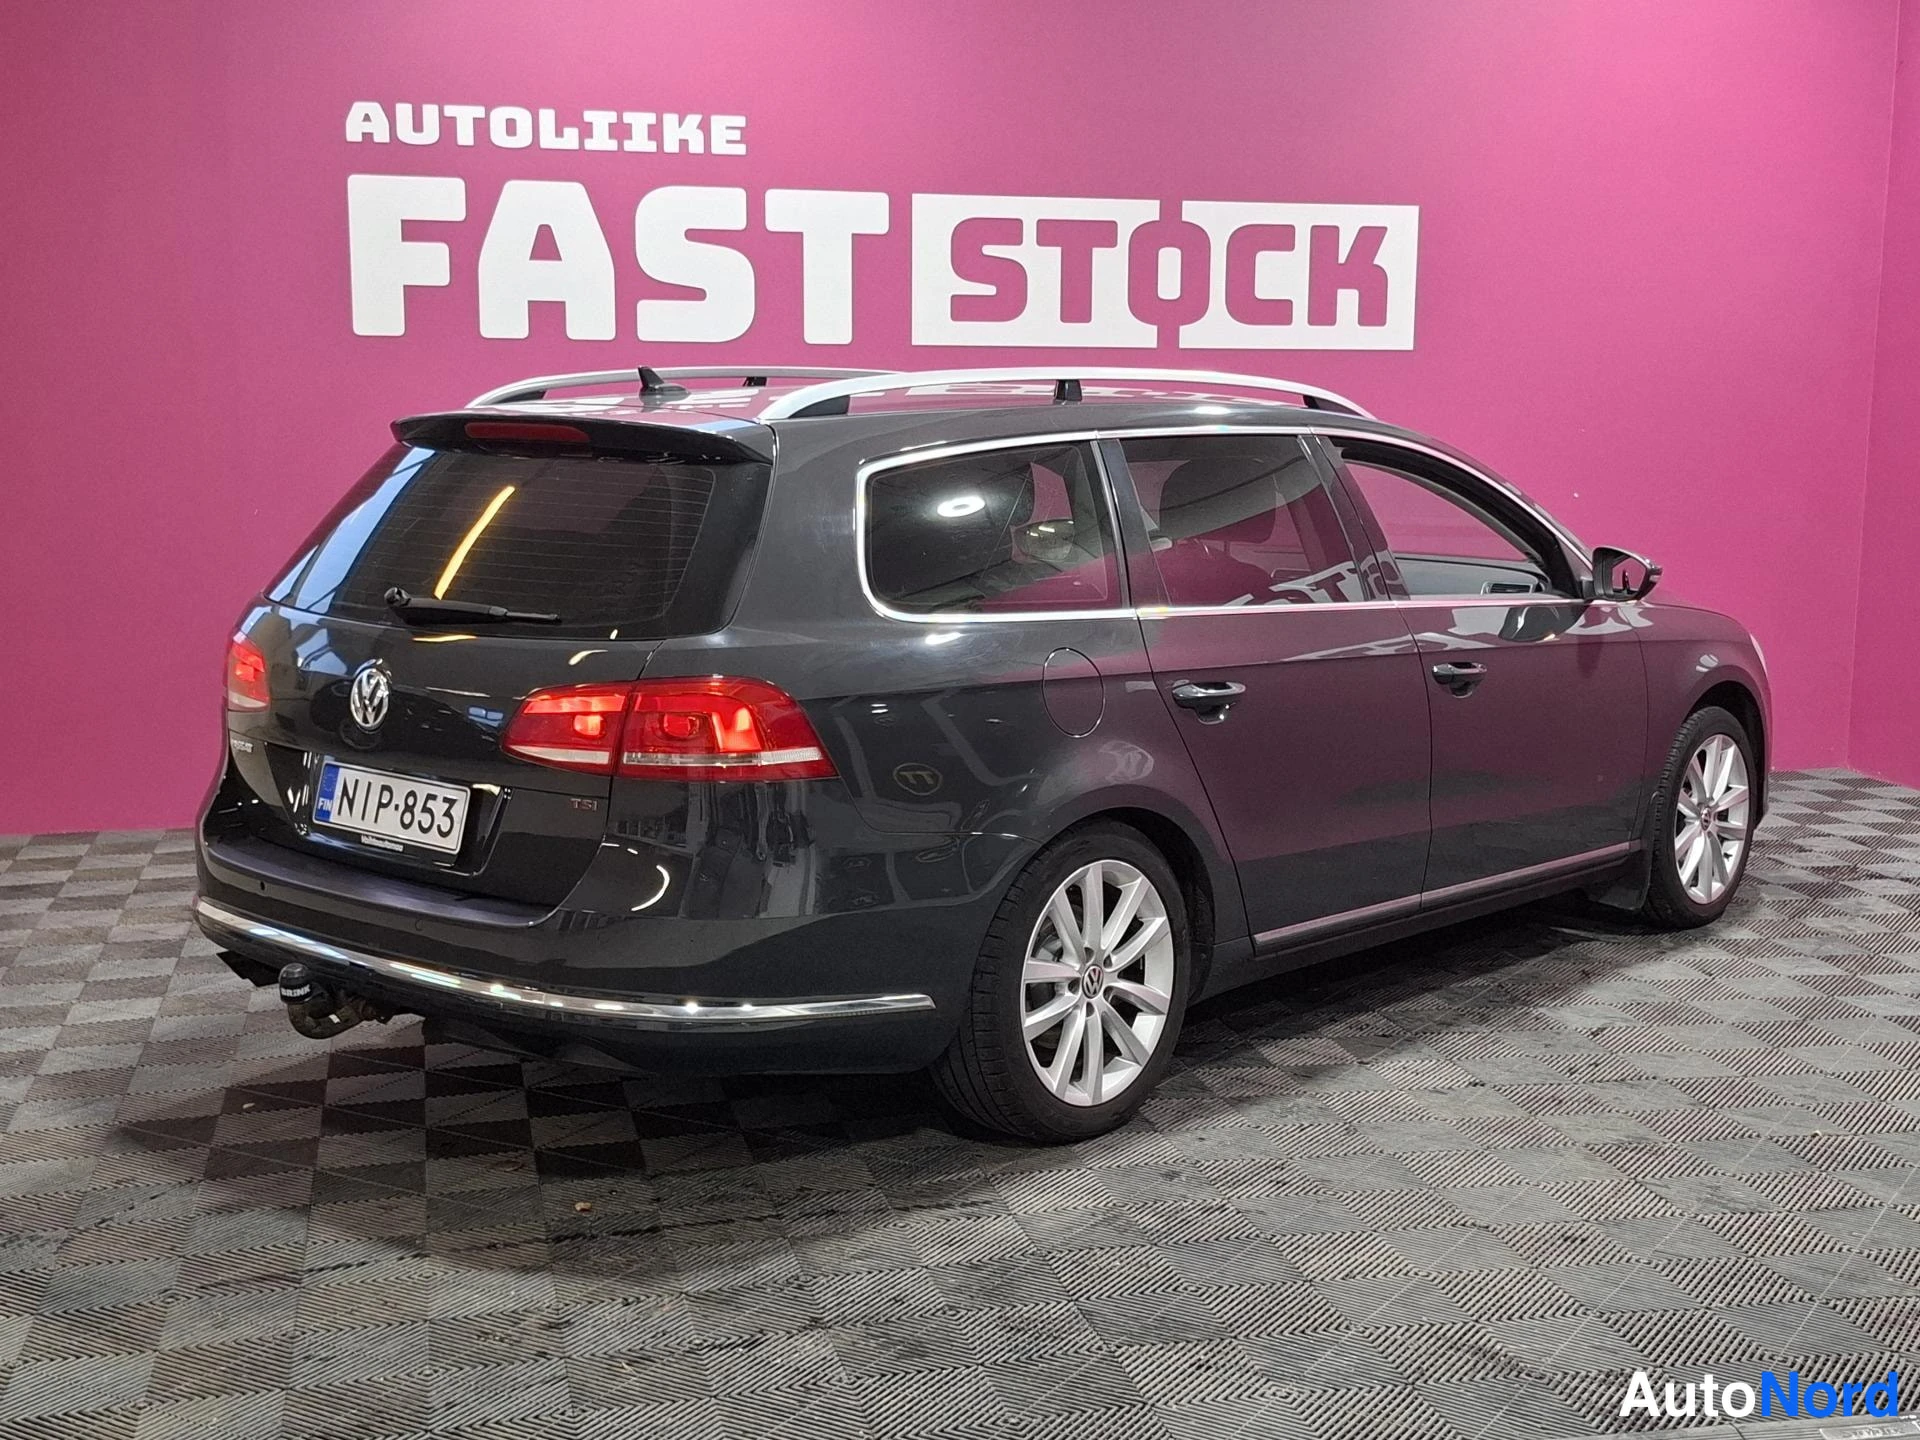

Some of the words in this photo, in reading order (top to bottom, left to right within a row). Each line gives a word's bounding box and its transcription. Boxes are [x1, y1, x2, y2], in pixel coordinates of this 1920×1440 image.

[346, 102, 746, 155] AUTOLIIKE
[348, 174, 889, 344] FAST
[950, 215, 1389, 328] STOCK
[318, 797, 333, 811] FIN
[337, 777, 458, 838] NIP-853
[570, 798, 598, 811] TSI
